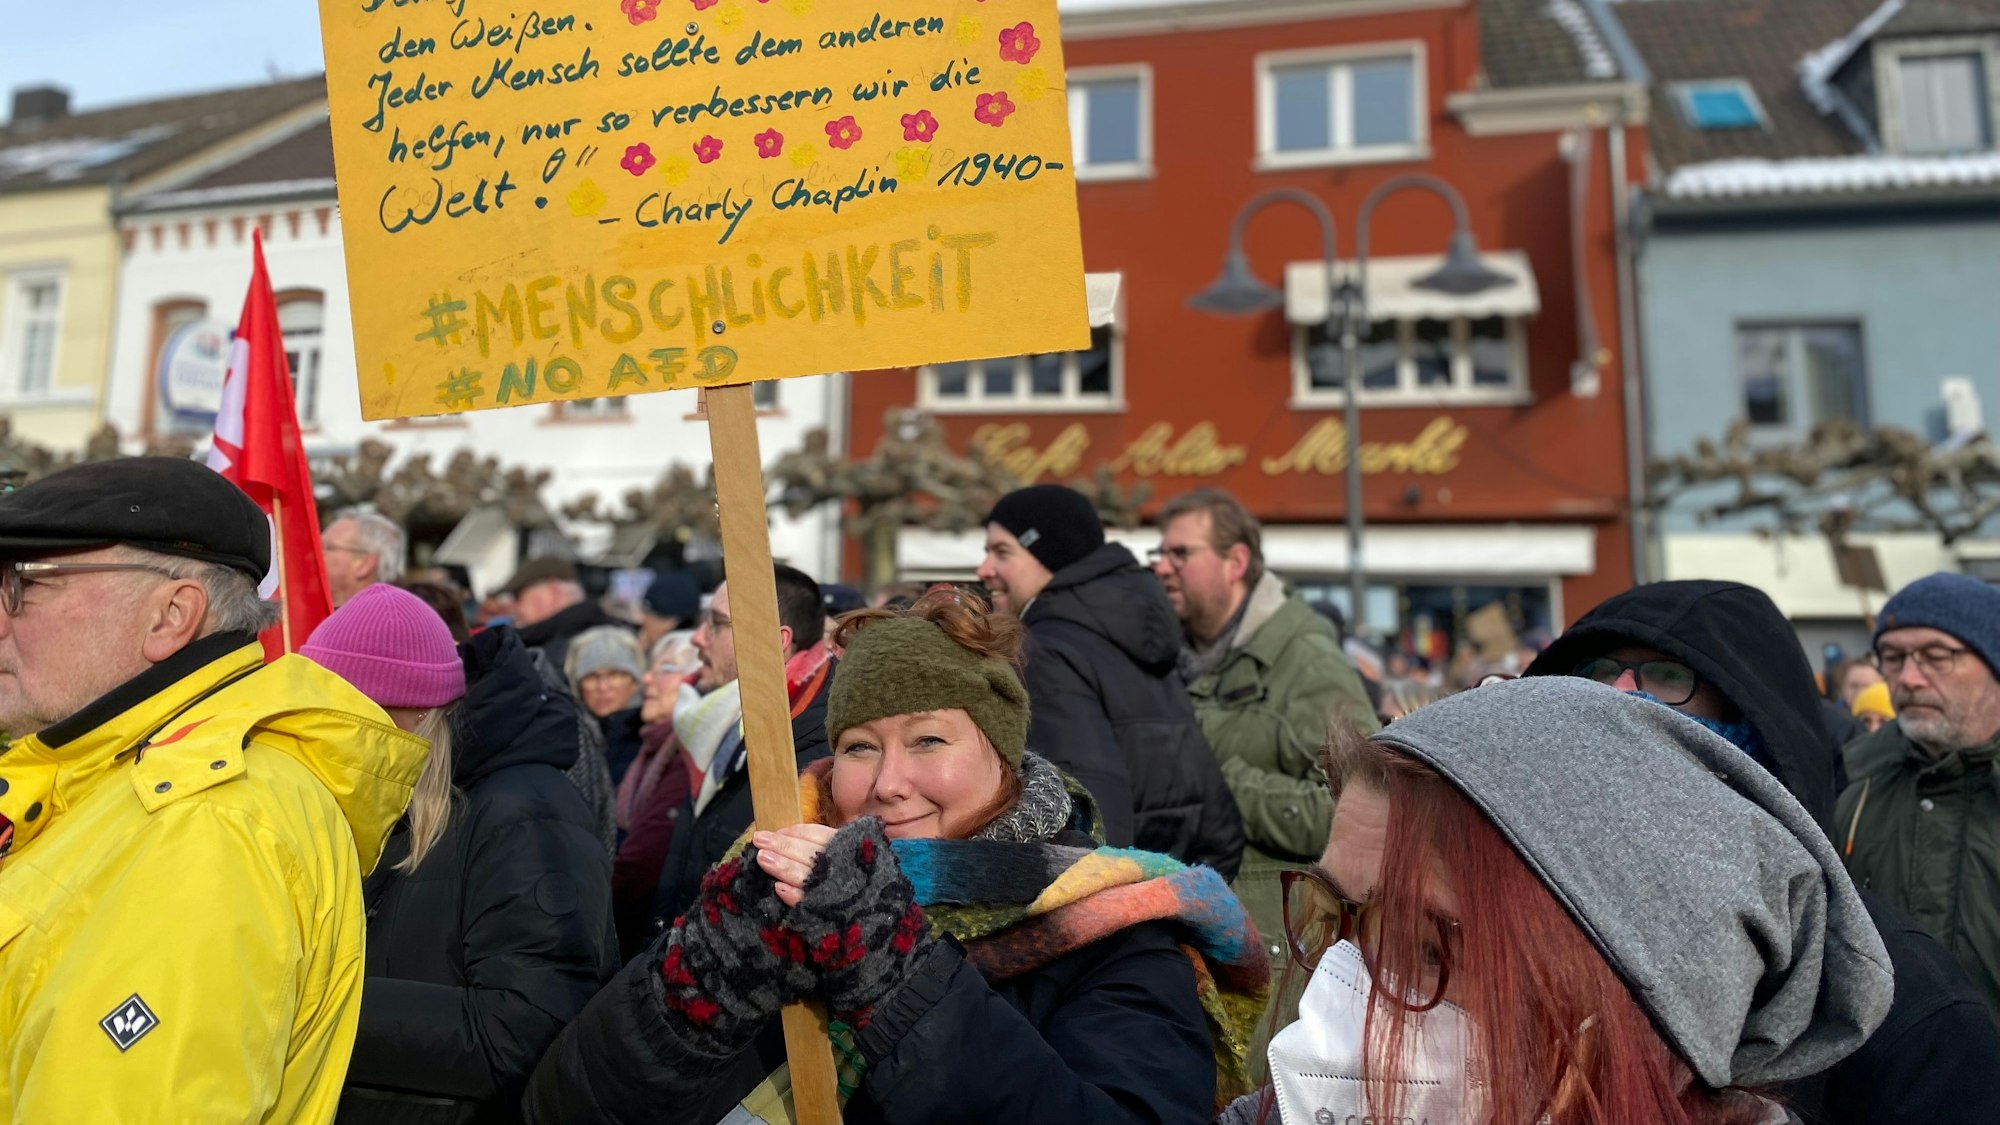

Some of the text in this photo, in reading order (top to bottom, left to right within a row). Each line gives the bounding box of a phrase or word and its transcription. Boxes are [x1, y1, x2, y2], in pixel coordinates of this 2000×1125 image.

[362, 13, 944, 132] Jeder Mensch sollte dem anderen
[378, 11, 593, 63] den Weißen.
[388, 58, 981, 171] helfen, nur so verbessern wir die
[636, 189, 752, 244] Charly
[772, 166, 898, 214] Chaplin
[436, 345, 738, 409] #NO AFD
